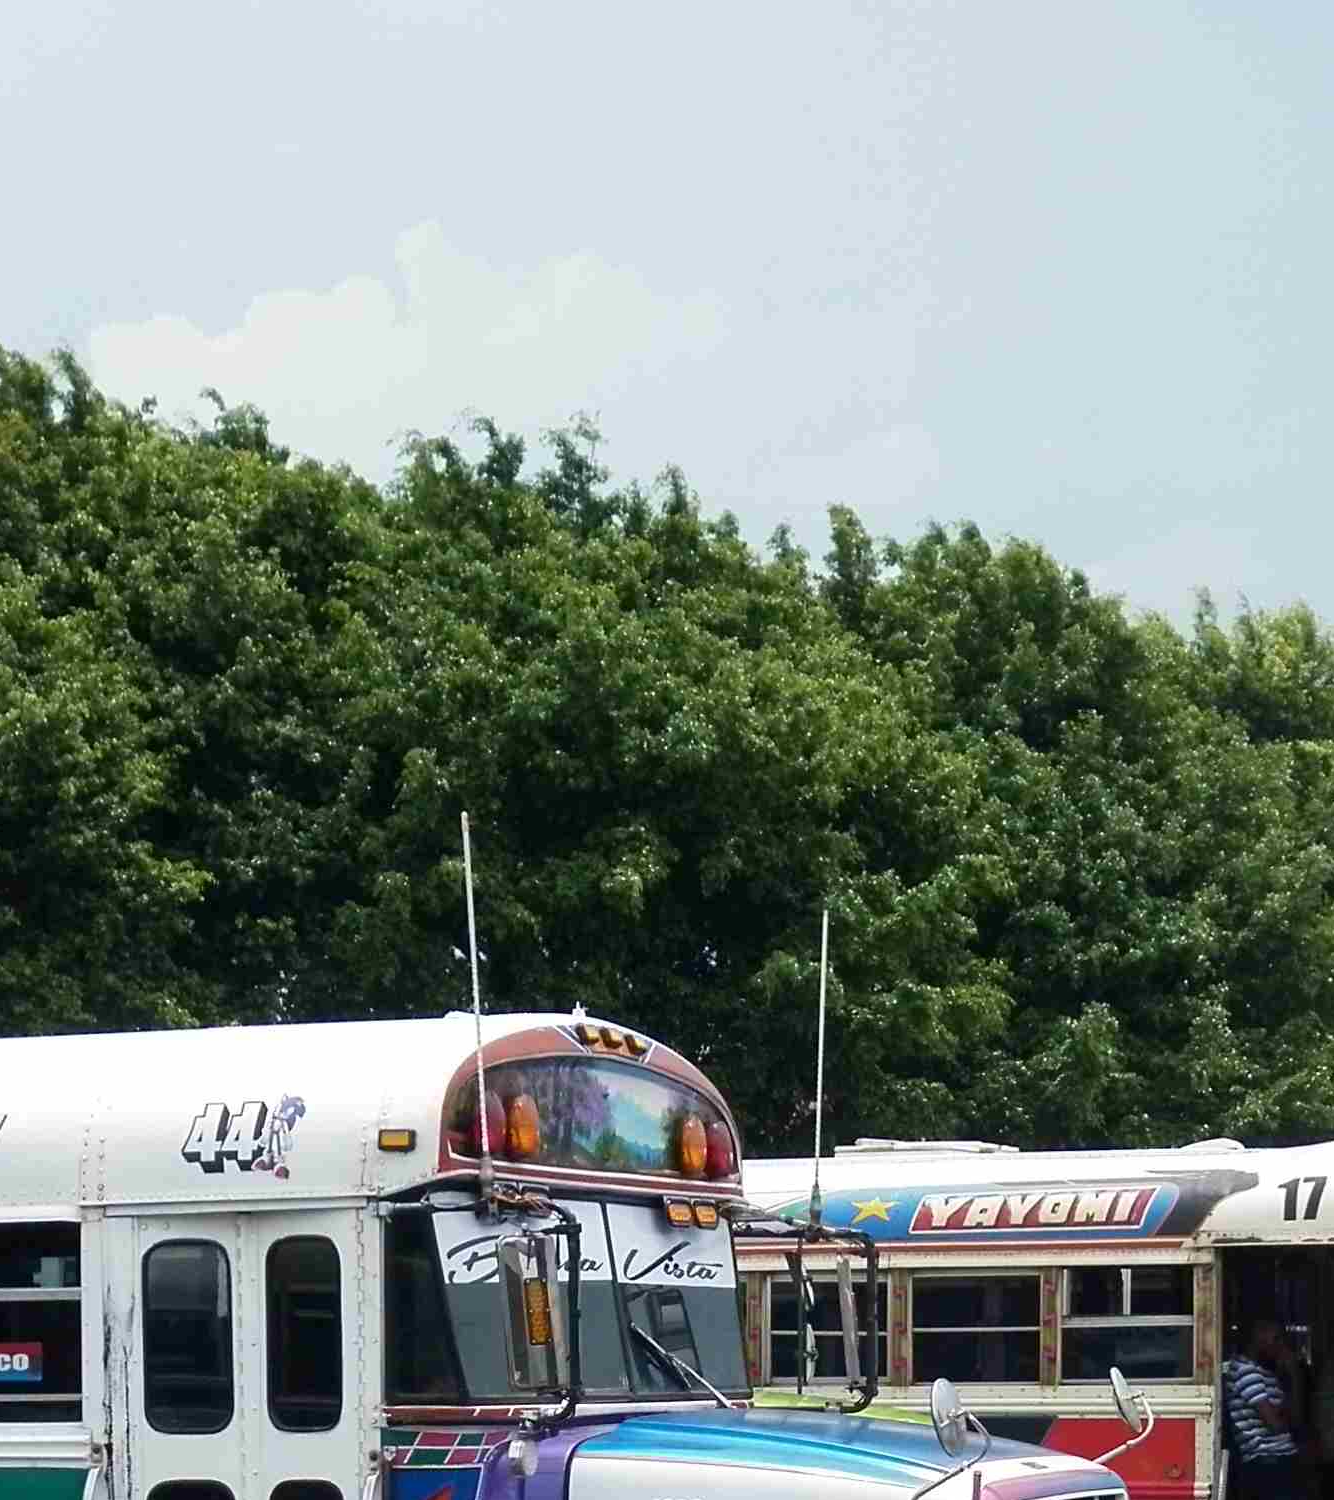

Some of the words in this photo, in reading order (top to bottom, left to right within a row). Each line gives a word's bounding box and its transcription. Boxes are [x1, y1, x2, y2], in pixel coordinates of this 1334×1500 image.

[181, 1101, 268, 1174] 44
[924, 1189, 1142, 1228] YAYOMI
[1278, 1176, 1328, 1221] 17
[623, 1241, 723, 1281] Vista
